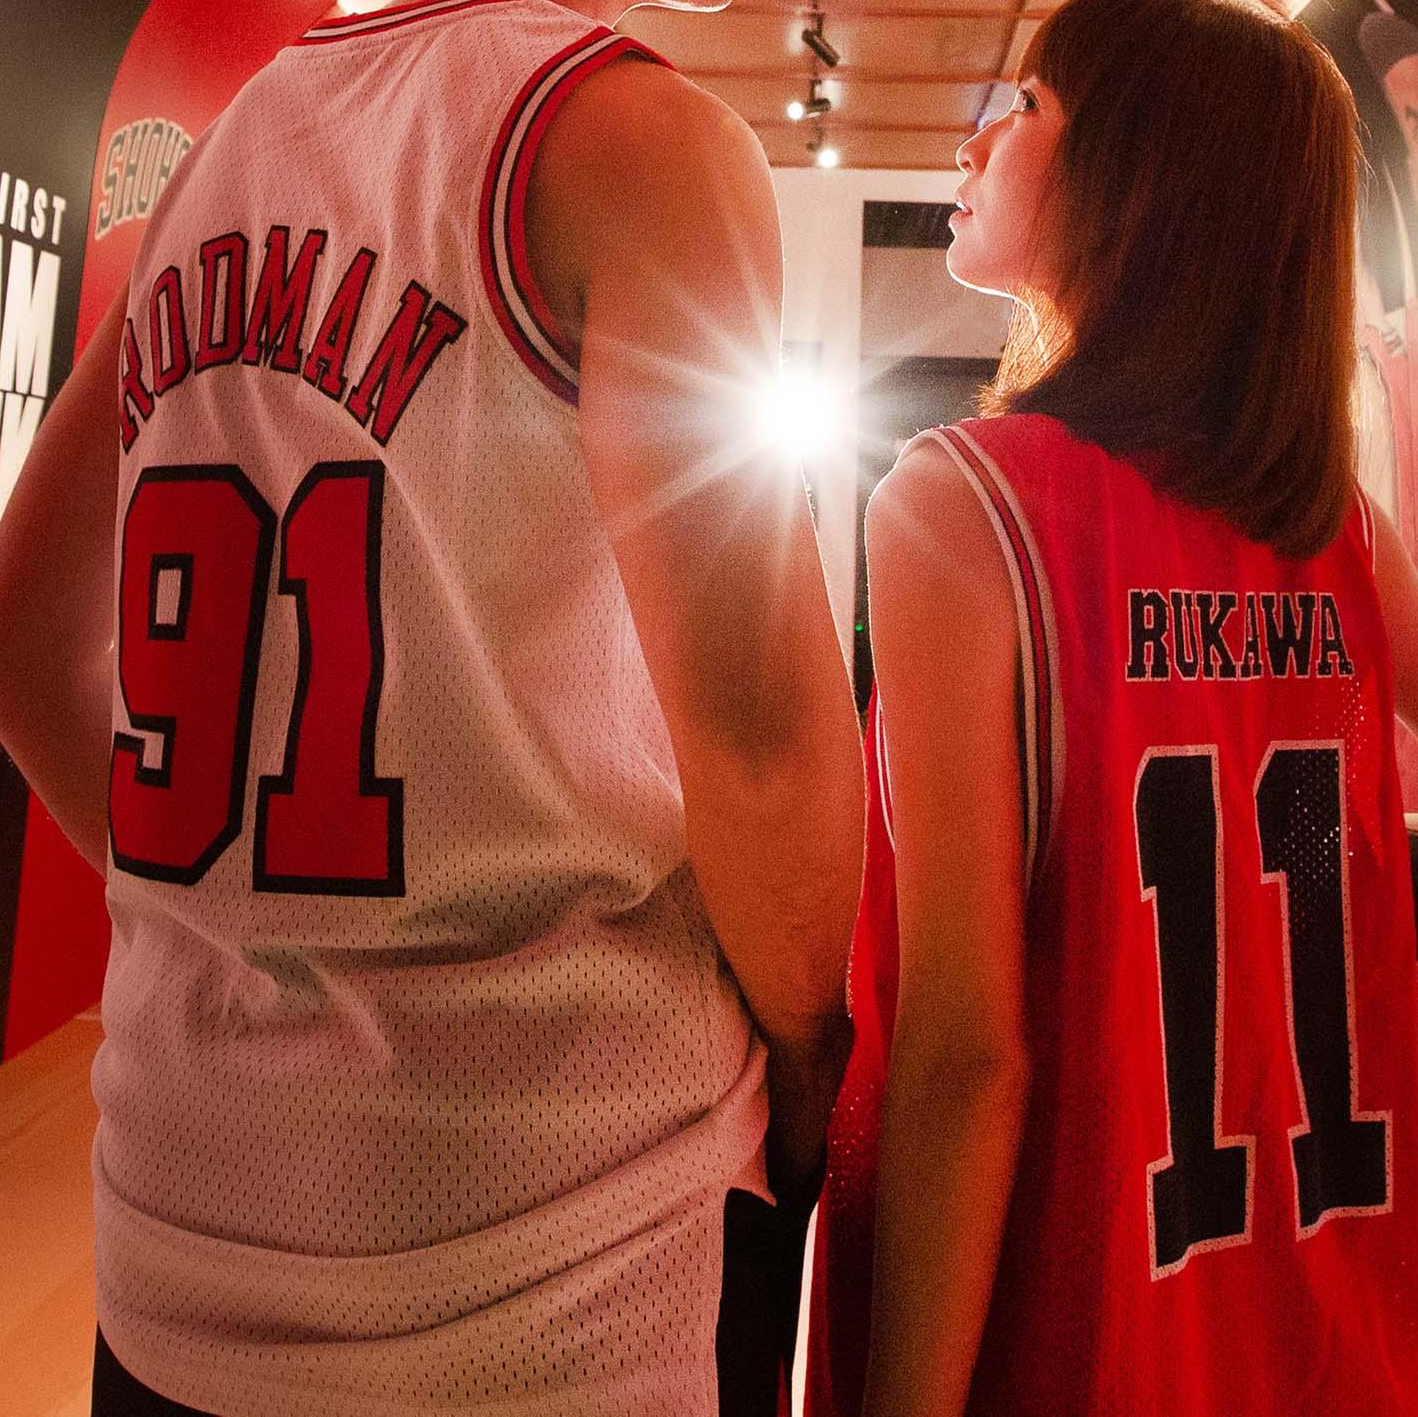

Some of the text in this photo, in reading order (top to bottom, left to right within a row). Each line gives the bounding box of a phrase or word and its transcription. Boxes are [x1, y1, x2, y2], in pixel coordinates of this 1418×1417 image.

[95, 117, 195, 242] SHOH
[119, 225, 467, 454] RODMAN
[109, 459, 406, 897] 91
[1125, 588, 1355, 682] RUKAWA
[1134, 738, 1394, 1283] 11
